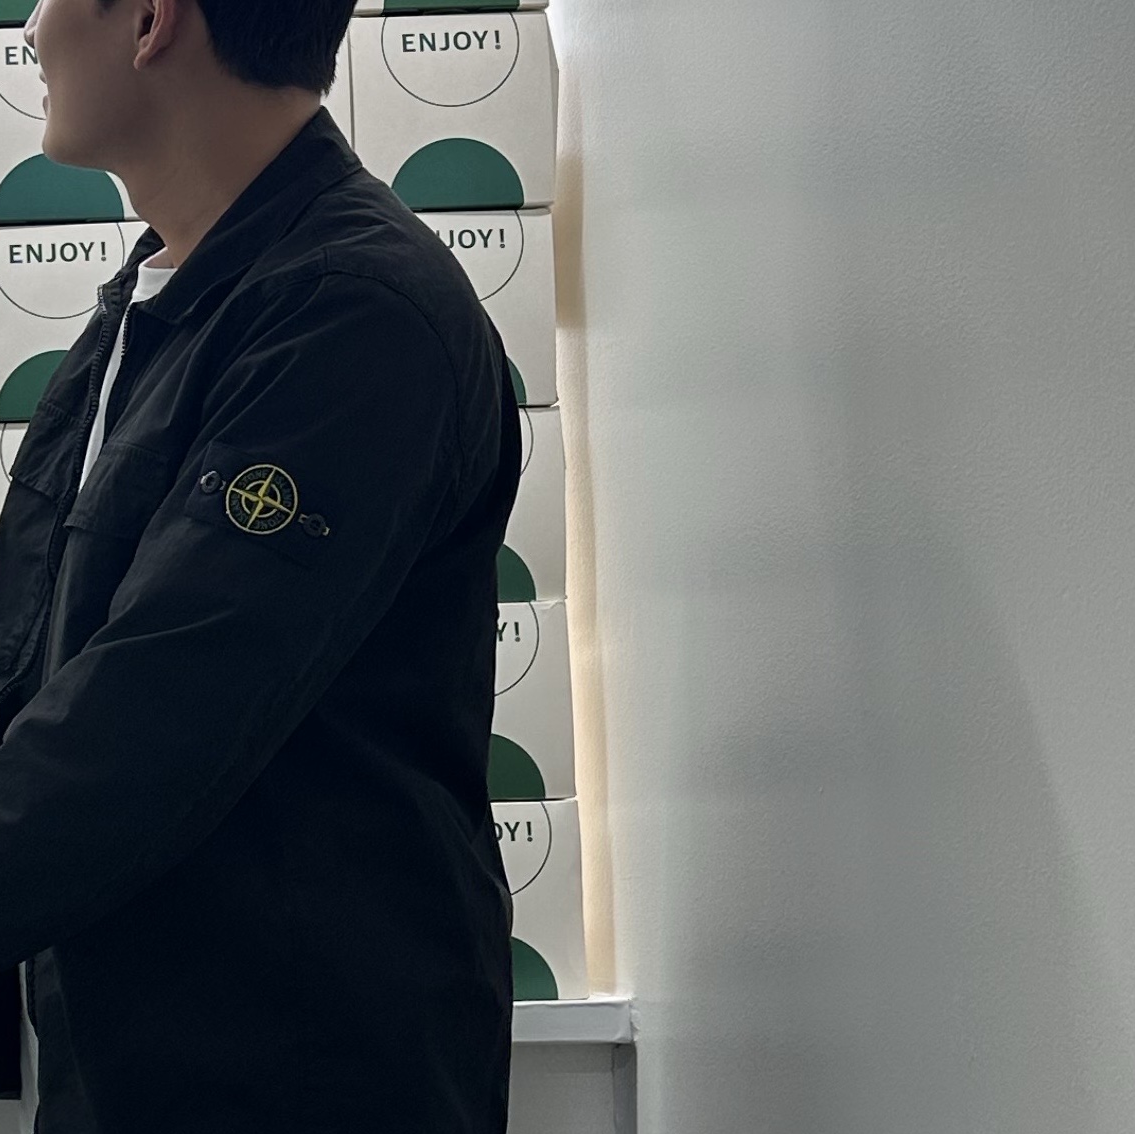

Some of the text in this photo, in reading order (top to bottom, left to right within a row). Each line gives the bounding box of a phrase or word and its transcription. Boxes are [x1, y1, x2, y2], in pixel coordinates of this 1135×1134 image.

[402, 30, 501, 52] ENJOY!
[436, 229, 506, 249] JOY!
[9, 242, 106, 263] ENJOY!
